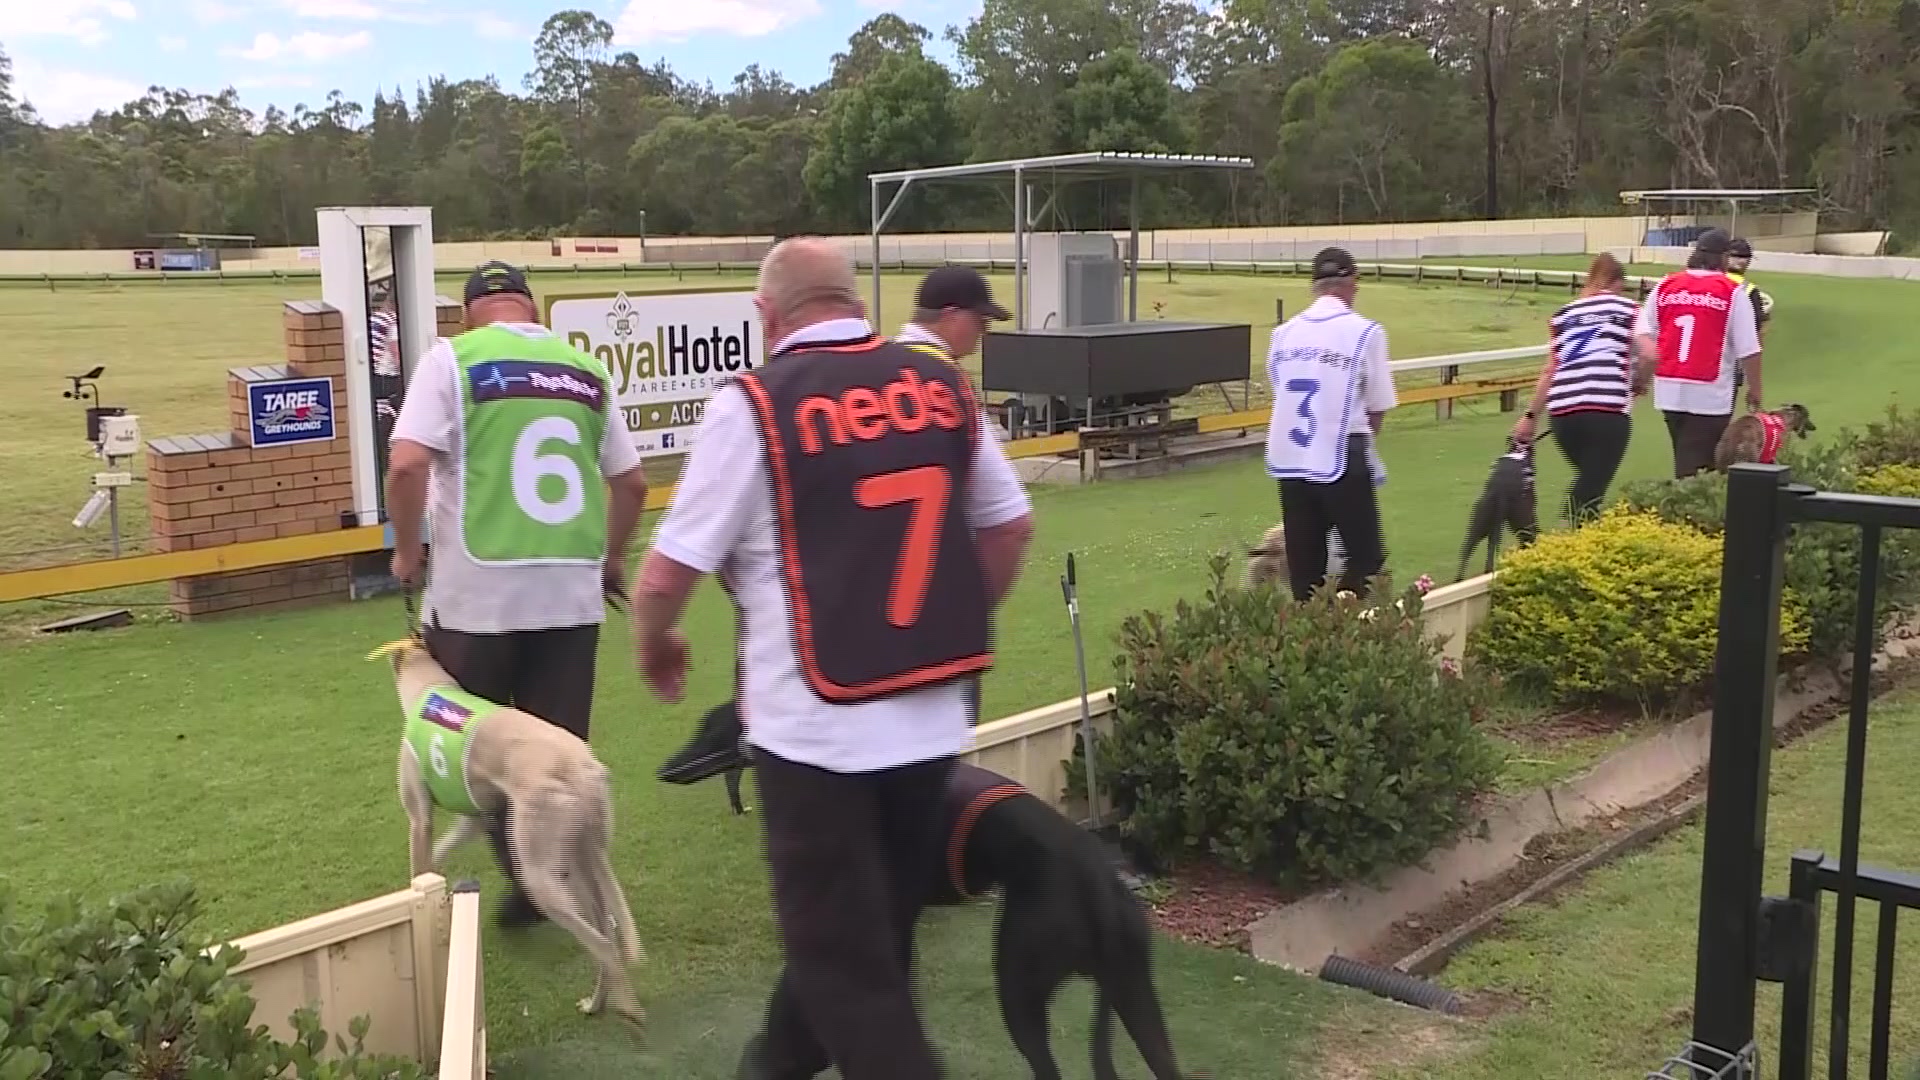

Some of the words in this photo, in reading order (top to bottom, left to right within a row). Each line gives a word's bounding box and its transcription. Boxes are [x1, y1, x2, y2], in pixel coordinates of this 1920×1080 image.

[1674, 314, 1695, 363] 1
[263, 390, 319, 412] TAREE
[632, 382, 677, 395] TAREE
[794, 367, 965, 455] neds
[1285, 379, 1320, 447] 3
[264, 420, 322, 435] GREYHOUNDS
[510, 416, 586, 525] 6
[853, 465, 952, 627] 7
[429, 733, 449, 777] 6
